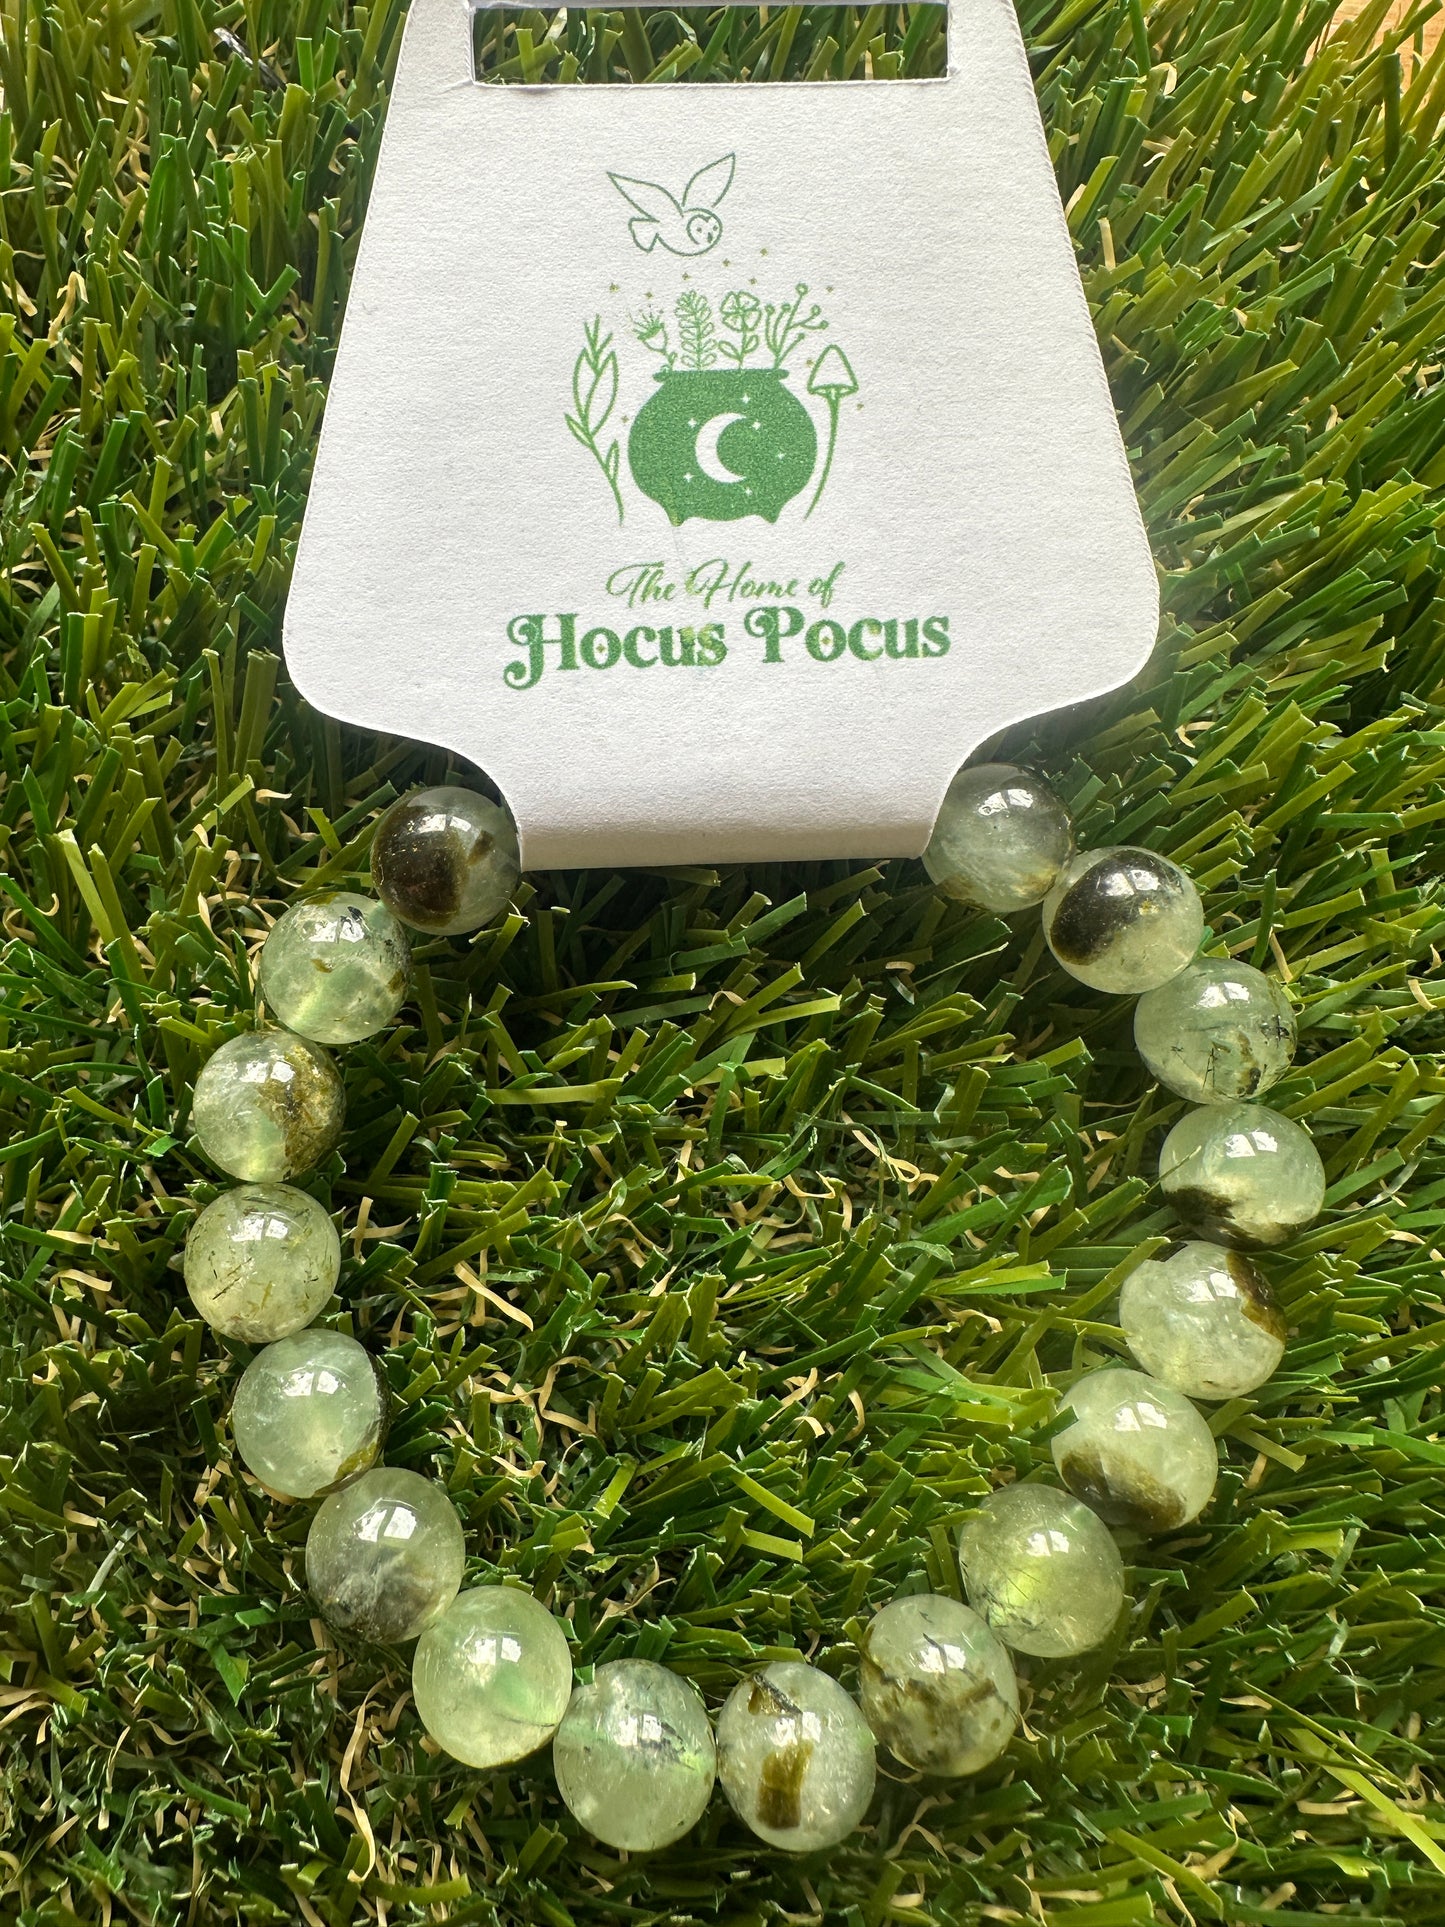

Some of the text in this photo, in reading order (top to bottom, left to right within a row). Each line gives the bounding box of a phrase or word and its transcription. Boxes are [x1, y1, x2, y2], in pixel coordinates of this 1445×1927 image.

[607, 559, 845, 609] The Home of
[504, 606, 950, 690] Hocus Pocus
